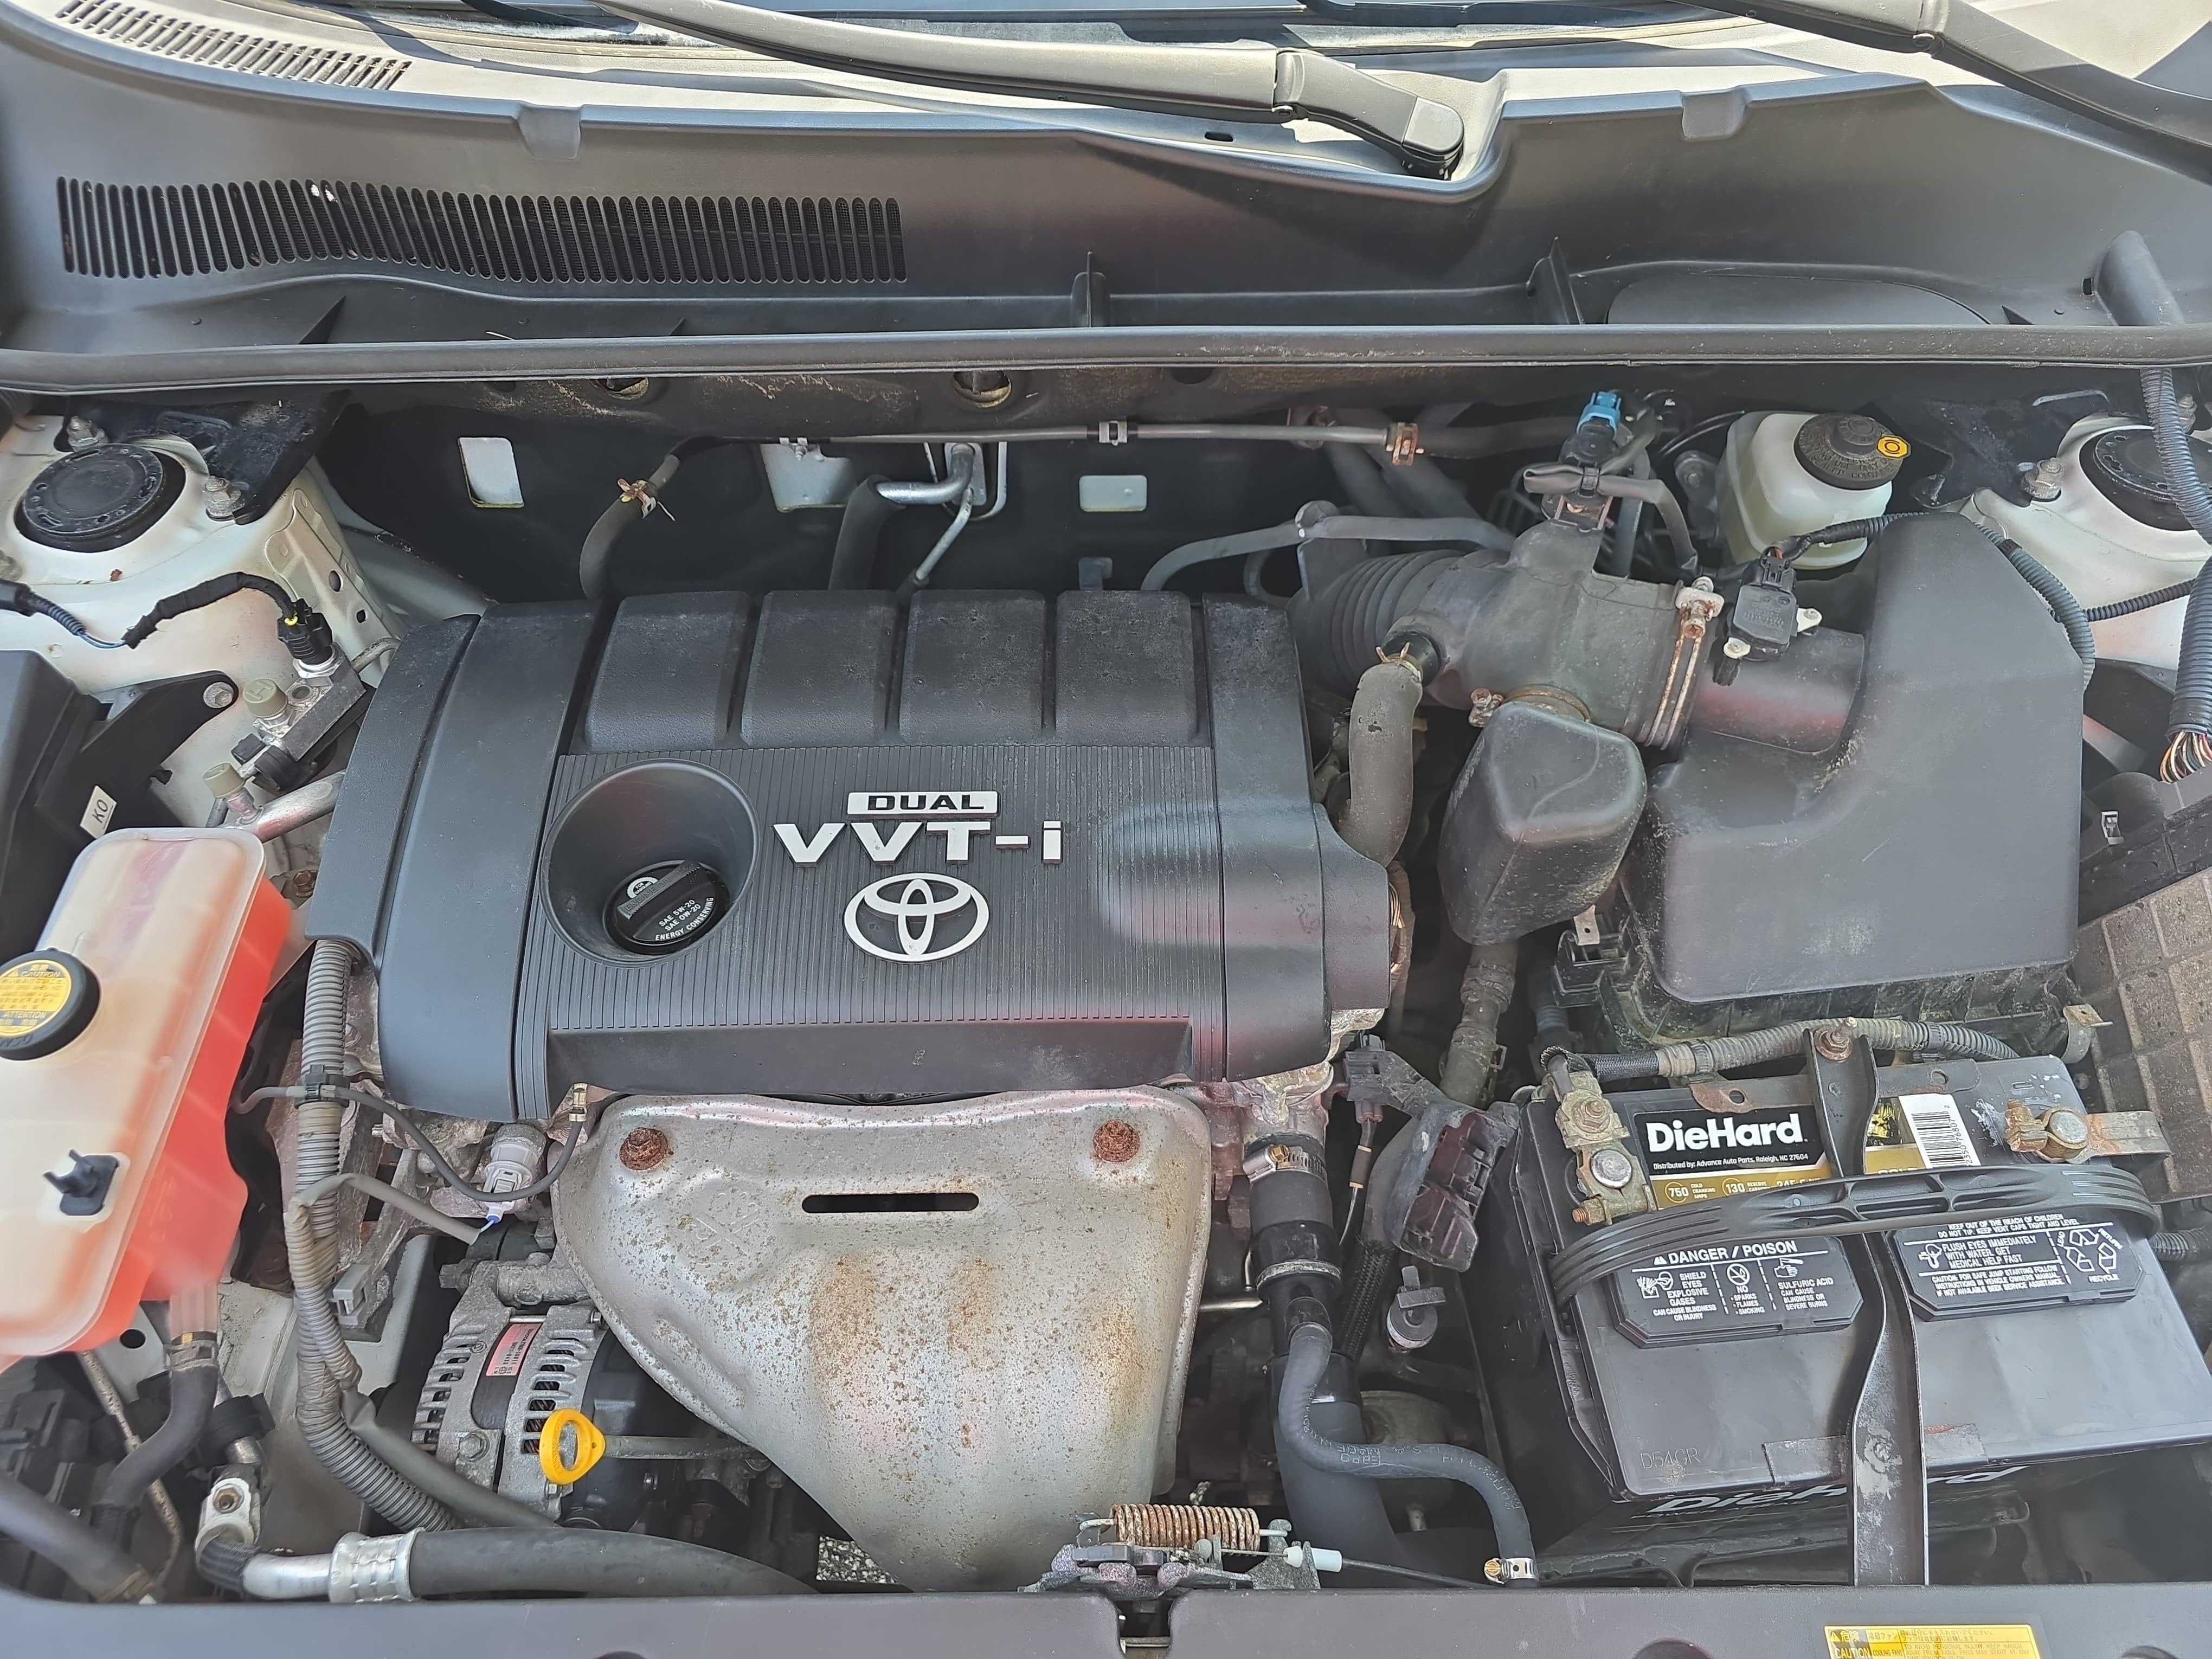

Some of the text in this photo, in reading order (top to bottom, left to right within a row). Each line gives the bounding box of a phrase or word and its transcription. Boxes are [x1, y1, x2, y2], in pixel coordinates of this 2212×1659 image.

[867, 795, 985, 811] DUAL
[773, 821, 1063, 865] VVT-i
[624, 877, 673, 911] ENGINE OIL
[655, 897, 714, 941] ENERGY CONSERVING
[659, 899, 696, 927] SAE 5W-20
[665, 904, 701, 931] SAE 0W-20
[1949, 1118, 1963, 1141] 76807
[1654, 1161, 1686, 1170] Distributed
[1686, 1161, 1696, 1169] by:
[1668, 1187, 1689, 1197] 750
[1725, 1183, 1745, 1193] 130
[2002, 1217, 2023, 1225] REACH
[2034, 1213, 2064, 1222] CHILDREN
[1941, 1235, 2036, 1252] FLUSH EYES IMMEDIATELY
[2056, 1231, 2065, 1247] LEAD
[1669, 1248, 1728, 1264] DANGER
[1744, 1240, 1798, 1257] POISON
[1945, 1251, 1966, 1261] WITH
[1995, 1246, 2011, 1256] GET
[1949, 1253, 2023, 1269] MEDICAL HELP FAST
[1679, 1271, 1706, 1281] SHIELD
[1971, 1271, 1988, 1279] SAFE
[1988, 1270, 2004, 1278] JUMP
[2004, 1267, 2034, 1276] STARTING
[2033, 1265, 2058, 1273] FOLLOW
[1681, 1280, 1702, 1289] EYES
[1778, 1277, 1834, 1289] SULFURIC ACID
[1934, 1280, 1977, 1290] INSTRUCTIONS
[1984, 1276, 2009, 1285] VEHICLE
[2009, 1274, 2035, 1283] OWNERS
[1667, 1287, 1709, 1298] EXPLOSIVE
[1736, 1285, 1748, 1294] NO
[1943, 1289, 1957, 1297] NOT
[1957, 1285, 1988, 1295] AVAILABLE
[1986, 1284, 2004, 1293] SEEK
[2003, 1282, 2029, 1291] SERVICE
[1669, 1297, 1696, 1306] GASES
[1733, 1293, 1757, 1301] SPARKS
[1783, 1294, 1814, 1303] BLINDNESS
[1666, 1307, 1685, 1315] CAUSE
[1685, 1304, 1717, 1313] BLINDNESS
[1736, 1300, 1759, 1308] FLAMES
[1785, 1300, 1828, 1310] SEVERE BURNS
[1682, 1313, 1703, 1321] INJURY
[1739, 1307, 1765, 1315] SMOKING
[1840, 1630, 1861, 1642] 危険
[1835, 1647, 1870, 1659] CAUTION
